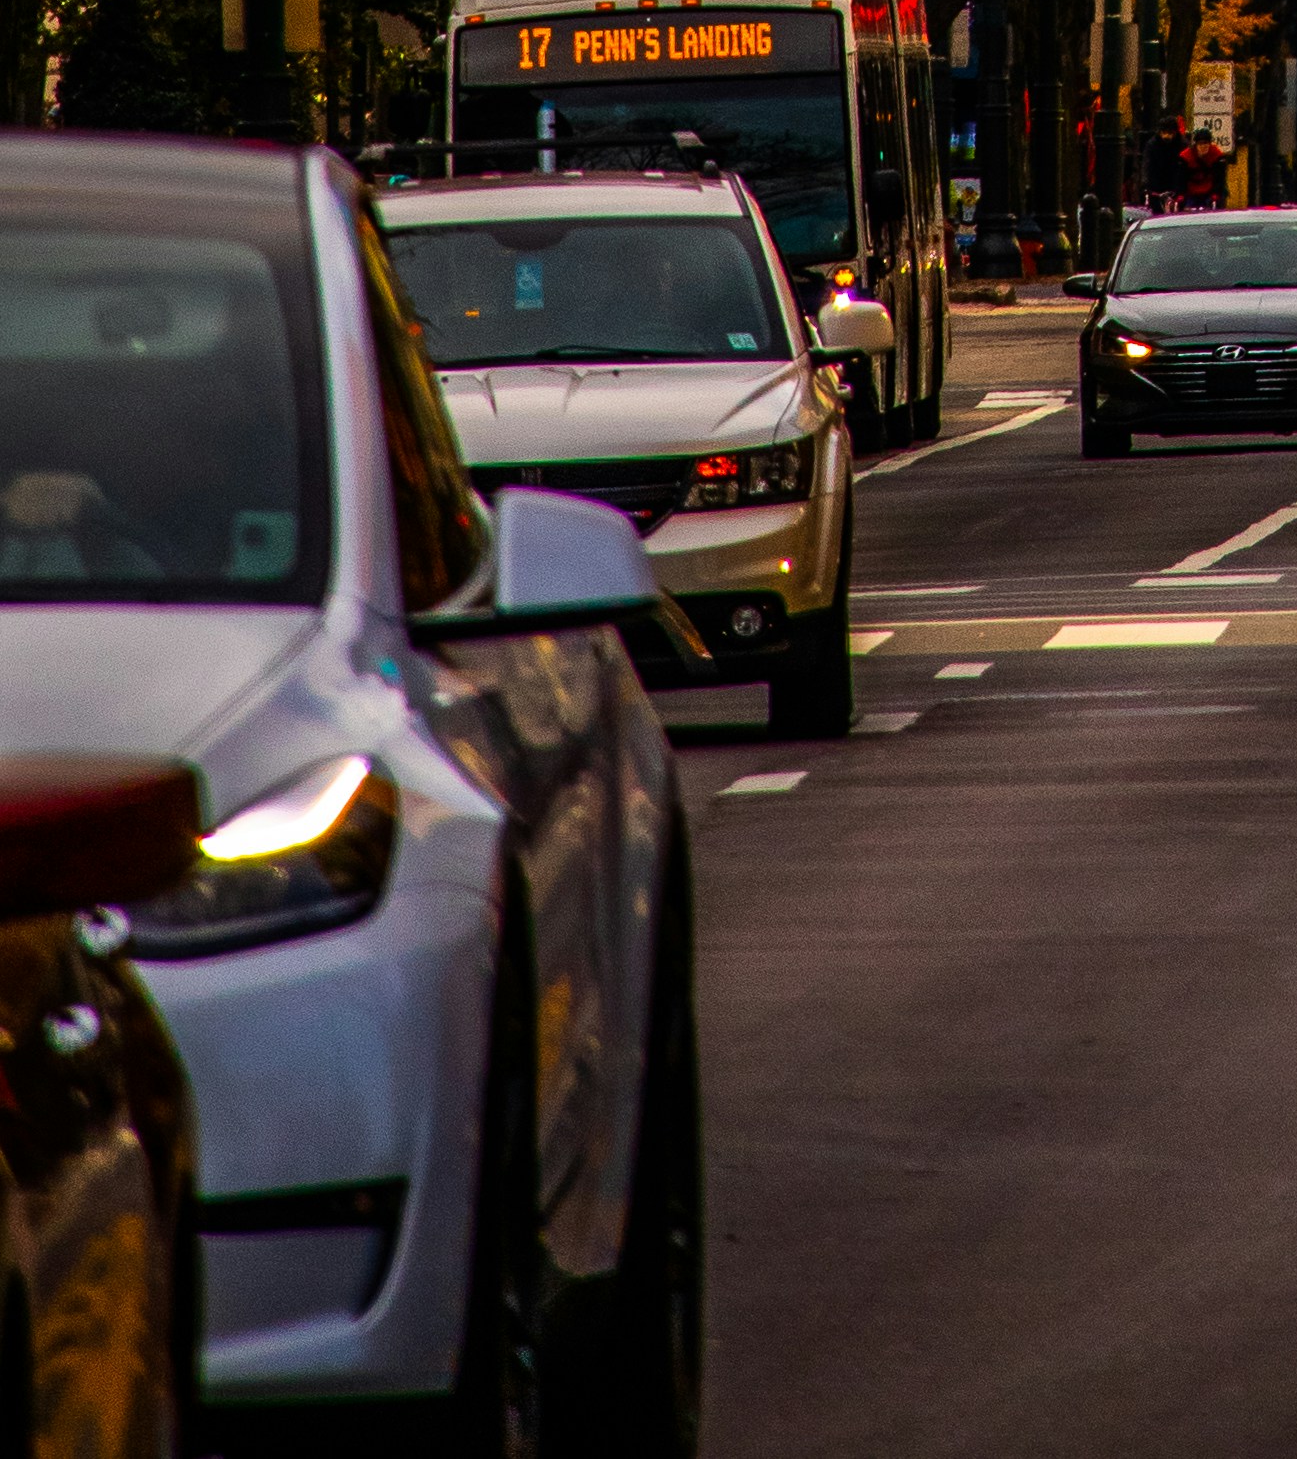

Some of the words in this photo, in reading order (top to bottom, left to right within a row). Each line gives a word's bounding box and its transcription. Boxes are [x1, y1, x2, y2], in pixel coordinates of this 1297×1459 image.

[518, 26, 552, 70] 17
[573, 26, 661, 64] PENN'S
[668, 22, 773, 60] LANDING
[1203, 118, 1223, 130] NO
